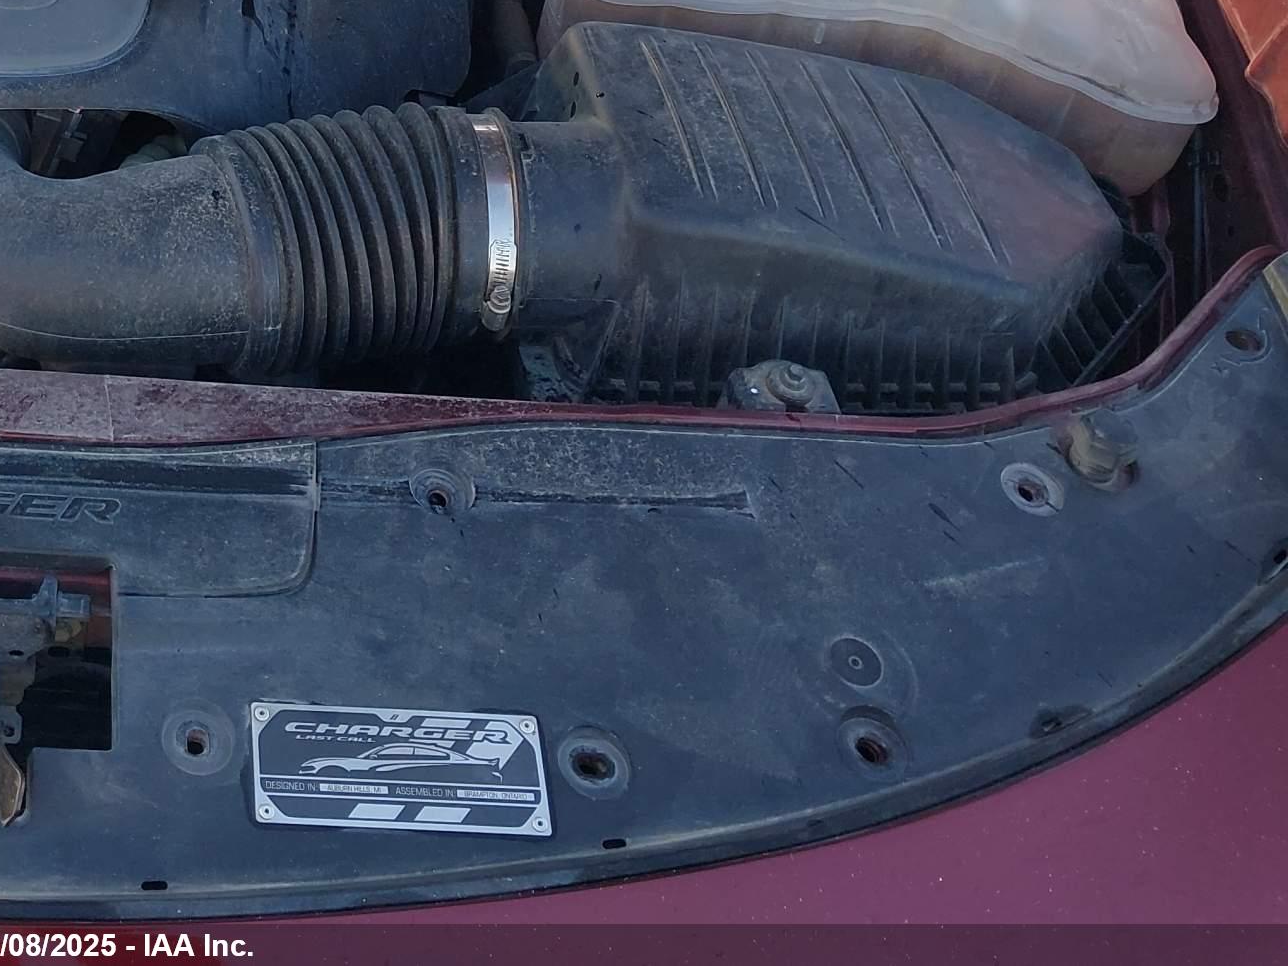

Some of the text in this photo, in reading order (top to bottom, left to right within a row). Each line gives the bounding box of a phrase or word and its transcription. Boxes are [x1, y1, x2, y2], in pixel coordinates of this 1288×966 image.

[285, 721, 514, 745] CHARGER
[265, 780, 306, 791] DESIGNED
[395, 786, 444, 797] ASSEMBLED
